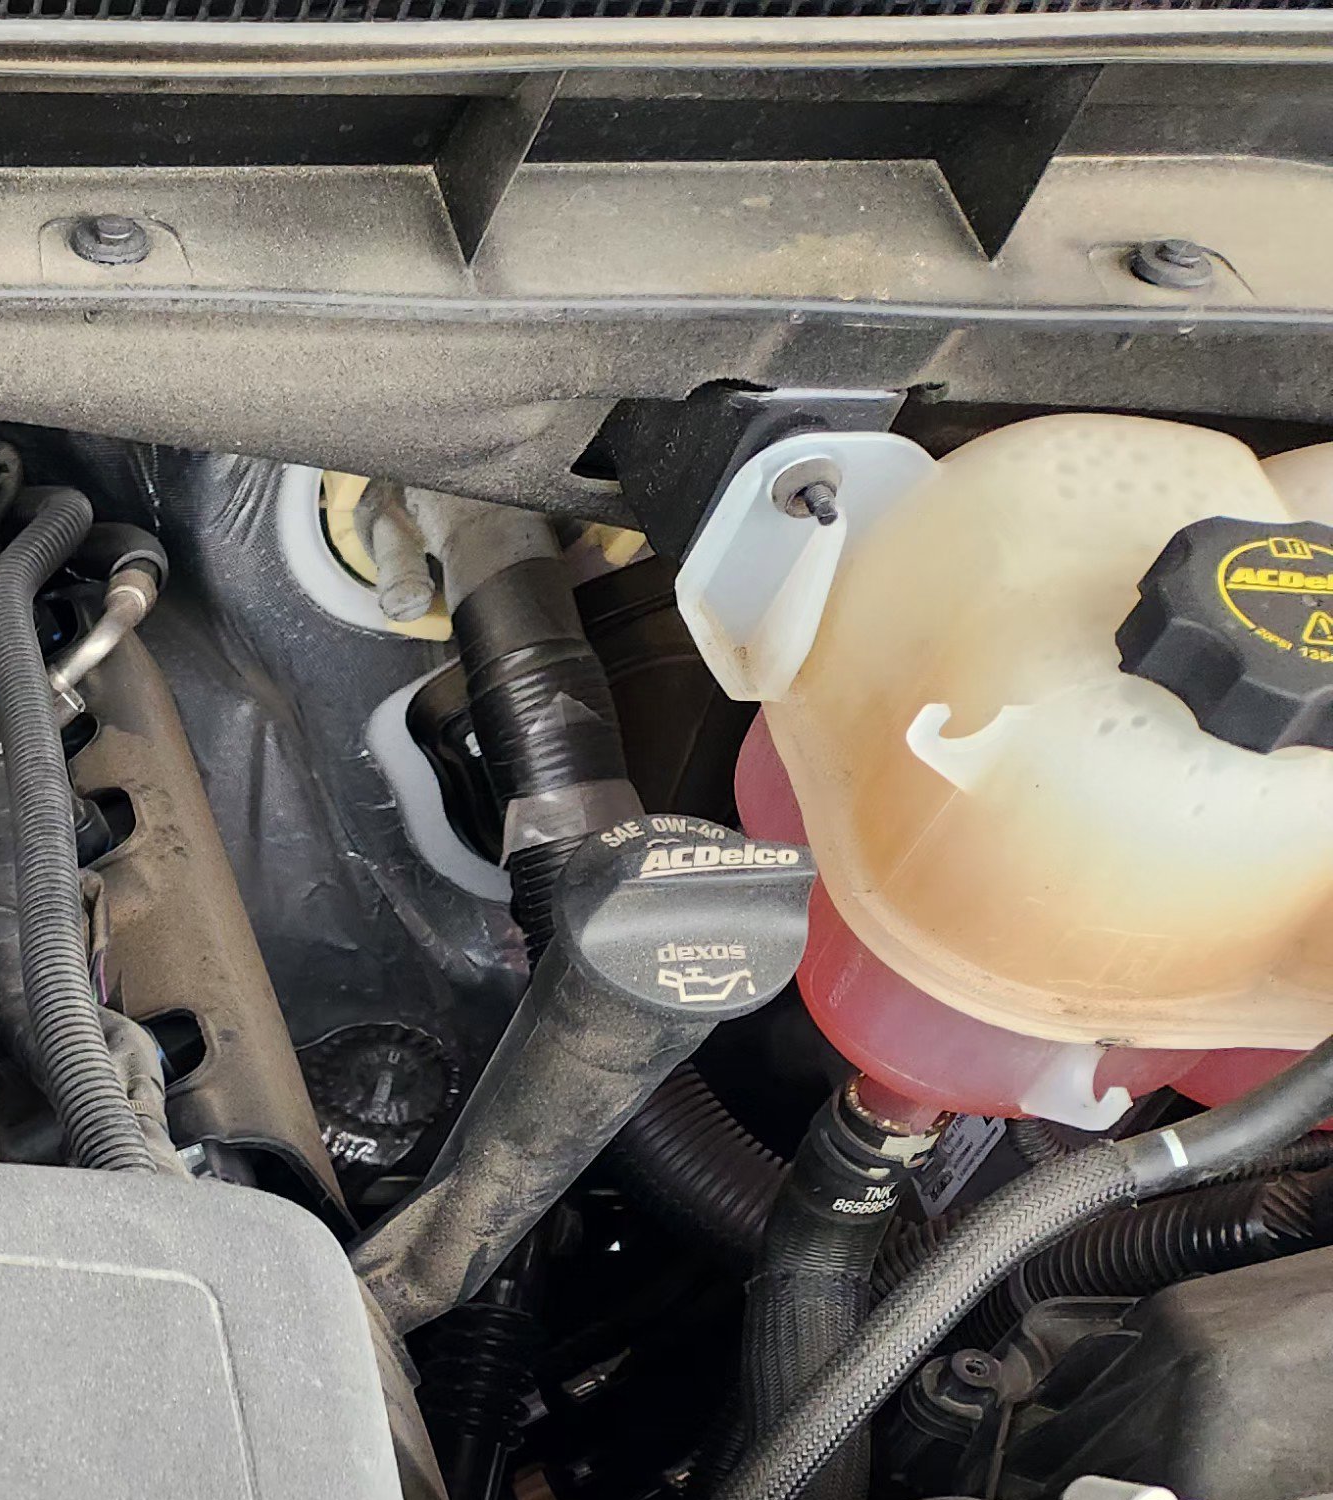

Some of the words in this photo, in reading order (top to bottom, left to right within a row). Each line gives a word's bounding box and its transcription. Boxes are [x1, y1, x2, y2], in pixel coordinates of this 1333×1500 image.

[600, 821, 645, 848] SAE
[651, 817, 725, 840] 0W-40
[640, 844, 799, 872] ACDelco
[657, 943, 747, 962] dexos
[864, 1181, 899, 1202] TNK
